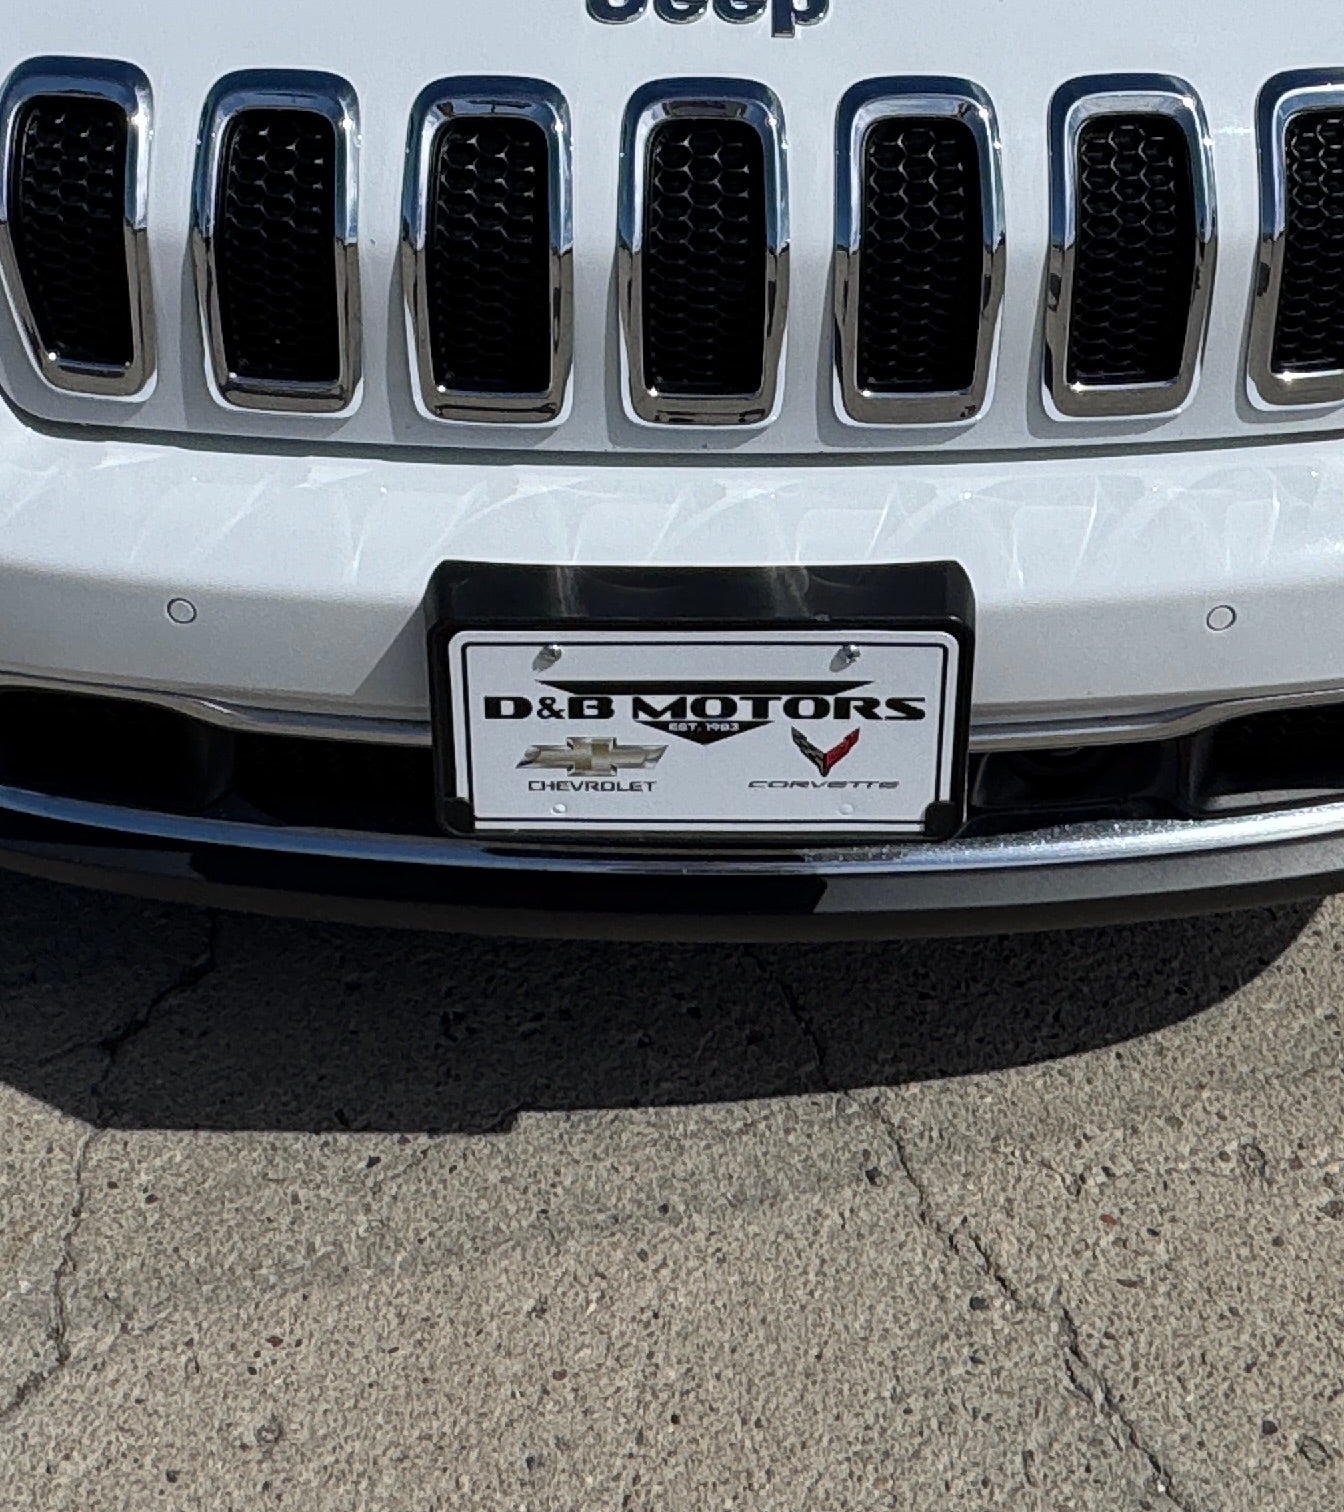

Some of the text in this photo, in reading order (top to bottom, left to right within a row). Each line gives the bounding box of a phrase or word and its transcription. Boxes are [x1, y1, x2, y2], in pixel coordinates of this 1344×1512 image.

[484, 695, 927, 721] D&B MOTORS
[528, 780, 658, 792] CHEVROLET
[748, 780, 900, 790] CORVETTE
